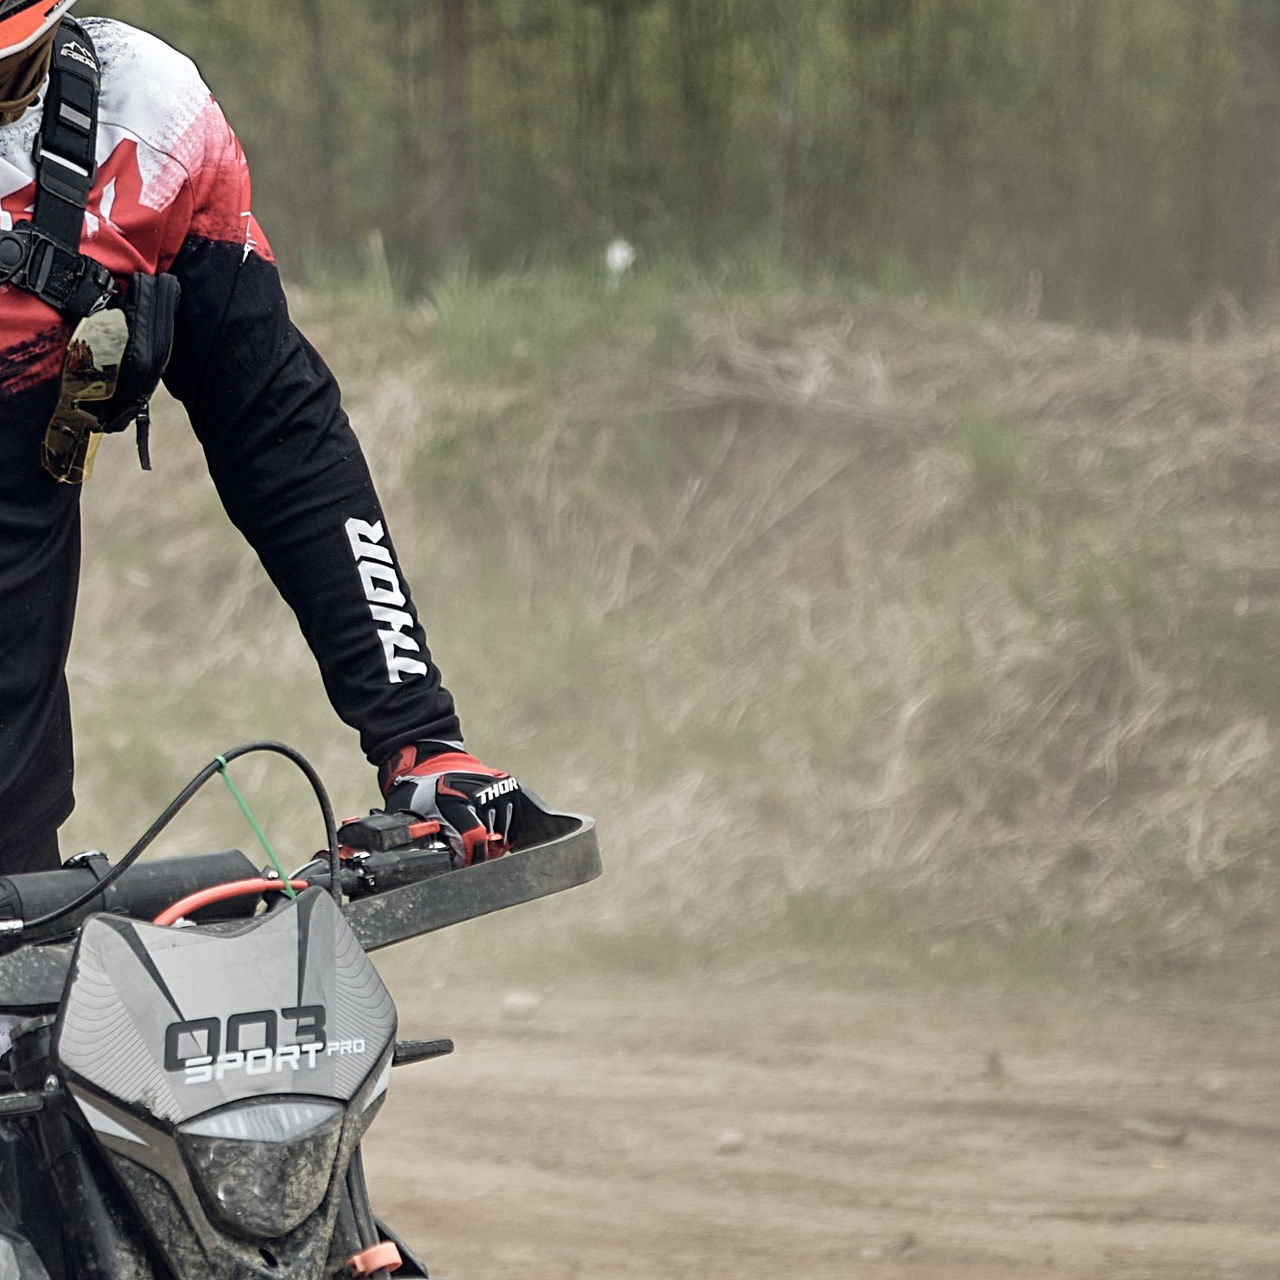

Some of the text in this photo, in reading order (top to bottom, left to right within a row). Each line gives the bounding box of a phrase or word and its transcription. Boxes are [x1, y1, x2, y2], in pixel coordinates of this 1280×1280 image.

[344, 517, 428, 684] THOR
[475, 777, 519, 805] THOR
[185, 1039, 366, 1085] SPORT PRO
